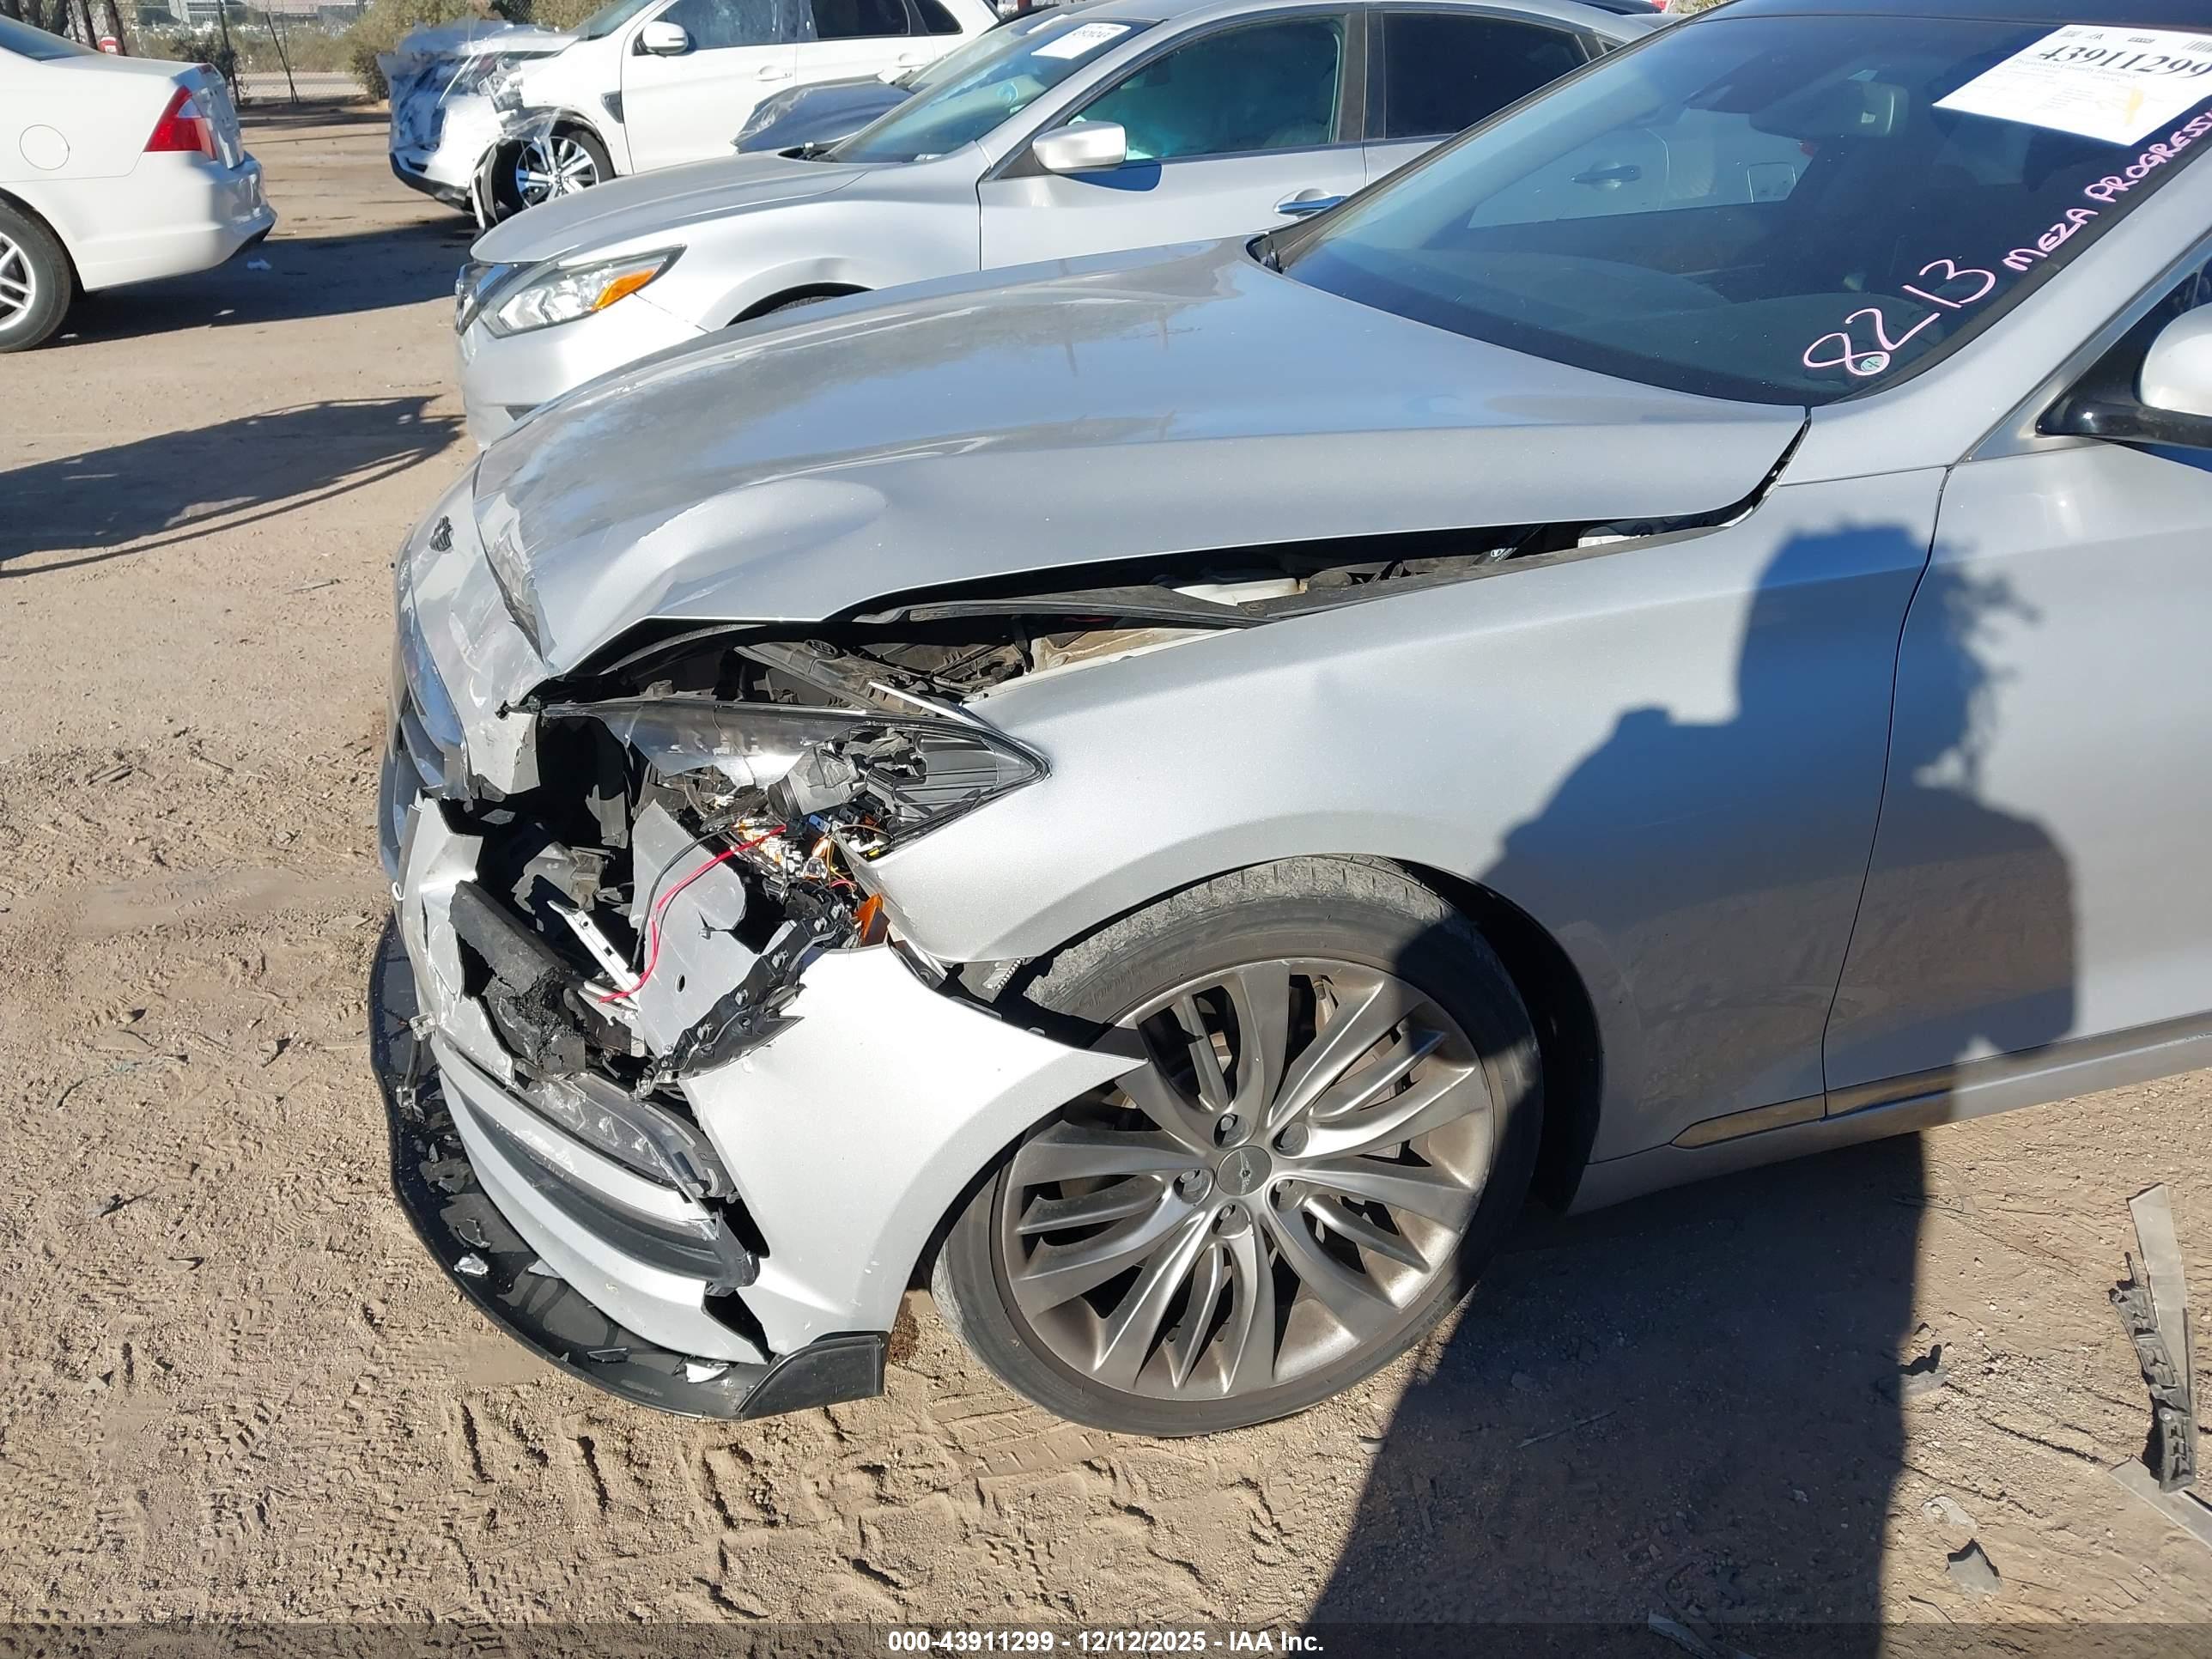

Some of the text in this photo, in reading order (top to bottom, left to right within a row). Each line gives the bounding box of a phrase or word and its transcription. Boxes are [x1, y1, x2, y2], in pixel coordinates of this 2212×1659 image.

[2039, 45, 2212, 79] 43911299
[1803, 258, 1996, 375] 8213
[2002, 206, 2098, 271] MEZA
